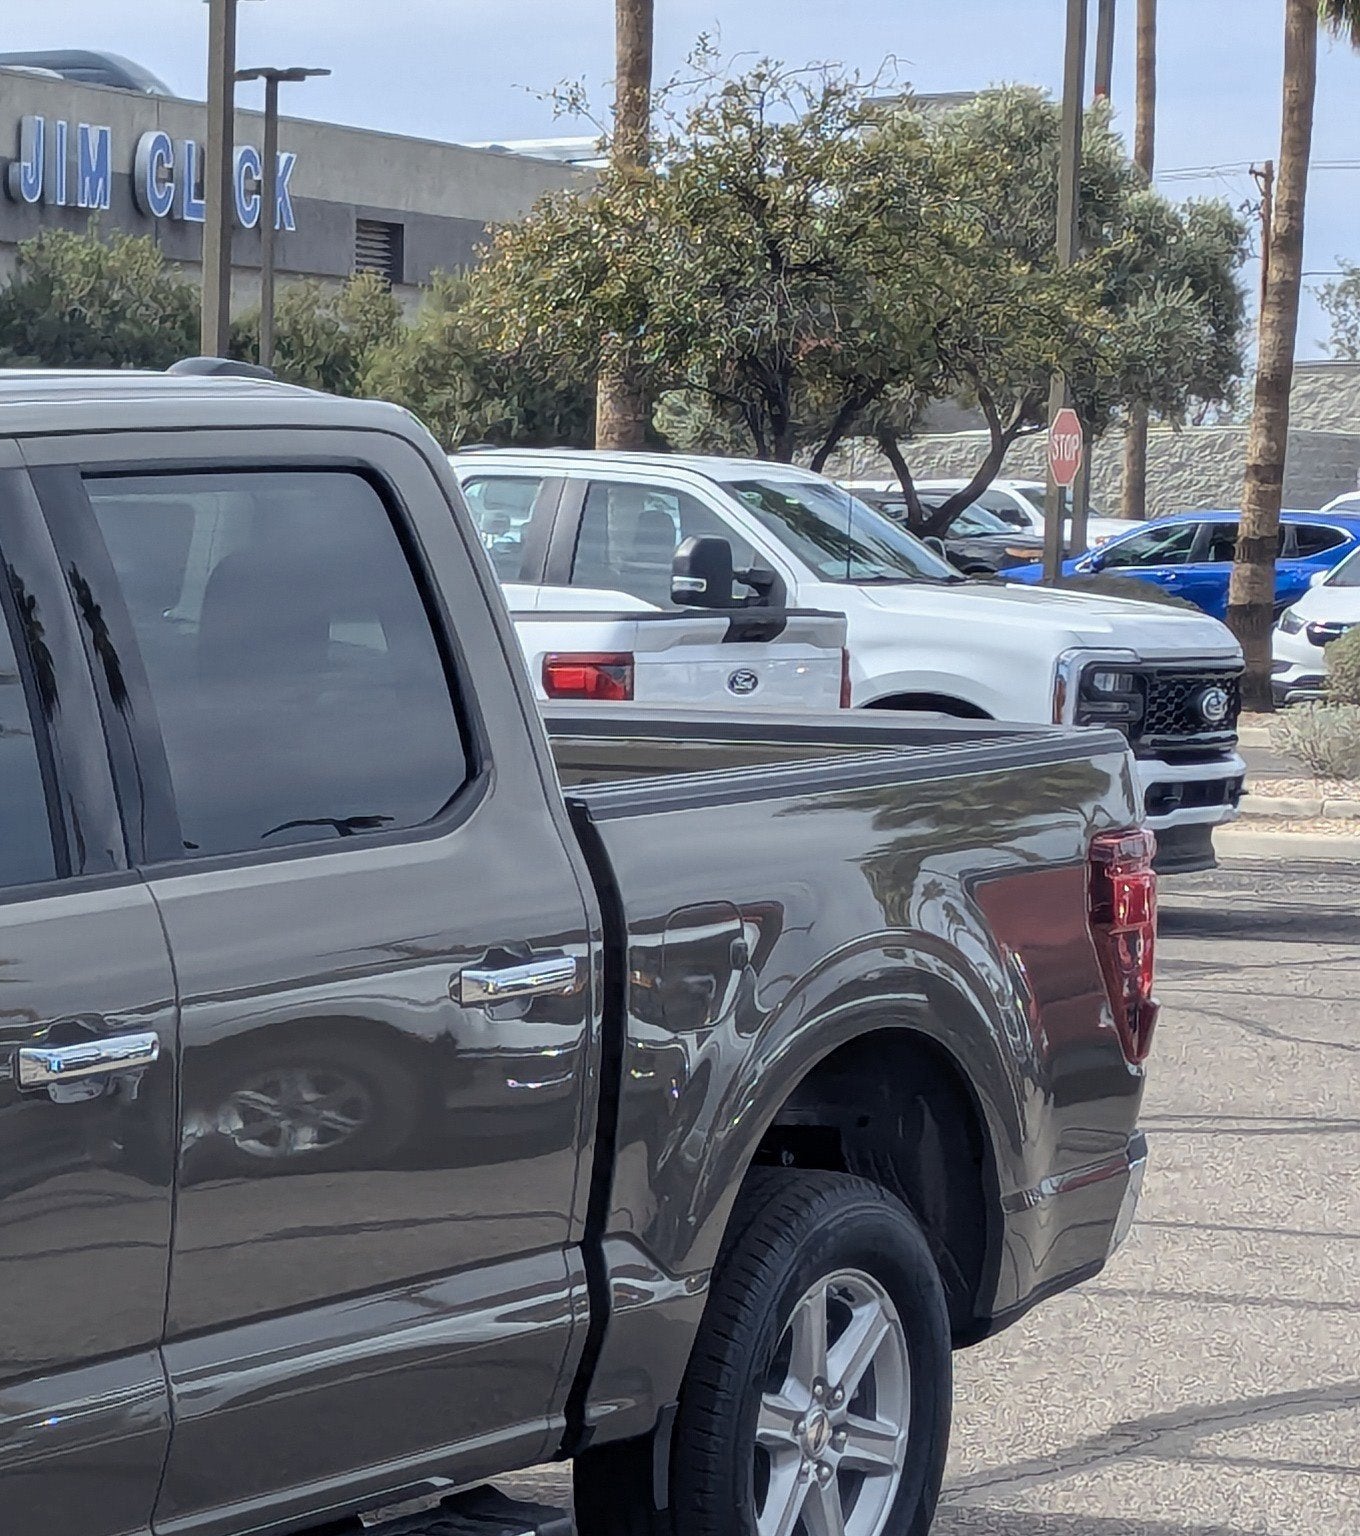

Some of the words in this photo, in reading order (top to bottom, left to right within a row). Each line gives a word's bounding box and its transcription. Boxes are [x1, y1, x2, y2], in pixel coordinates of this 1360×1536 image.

[10, 115, 112, 210] JIM
[135, 130, 297, 231] CLCK
[1052, 433, 1080, 461] STOP
